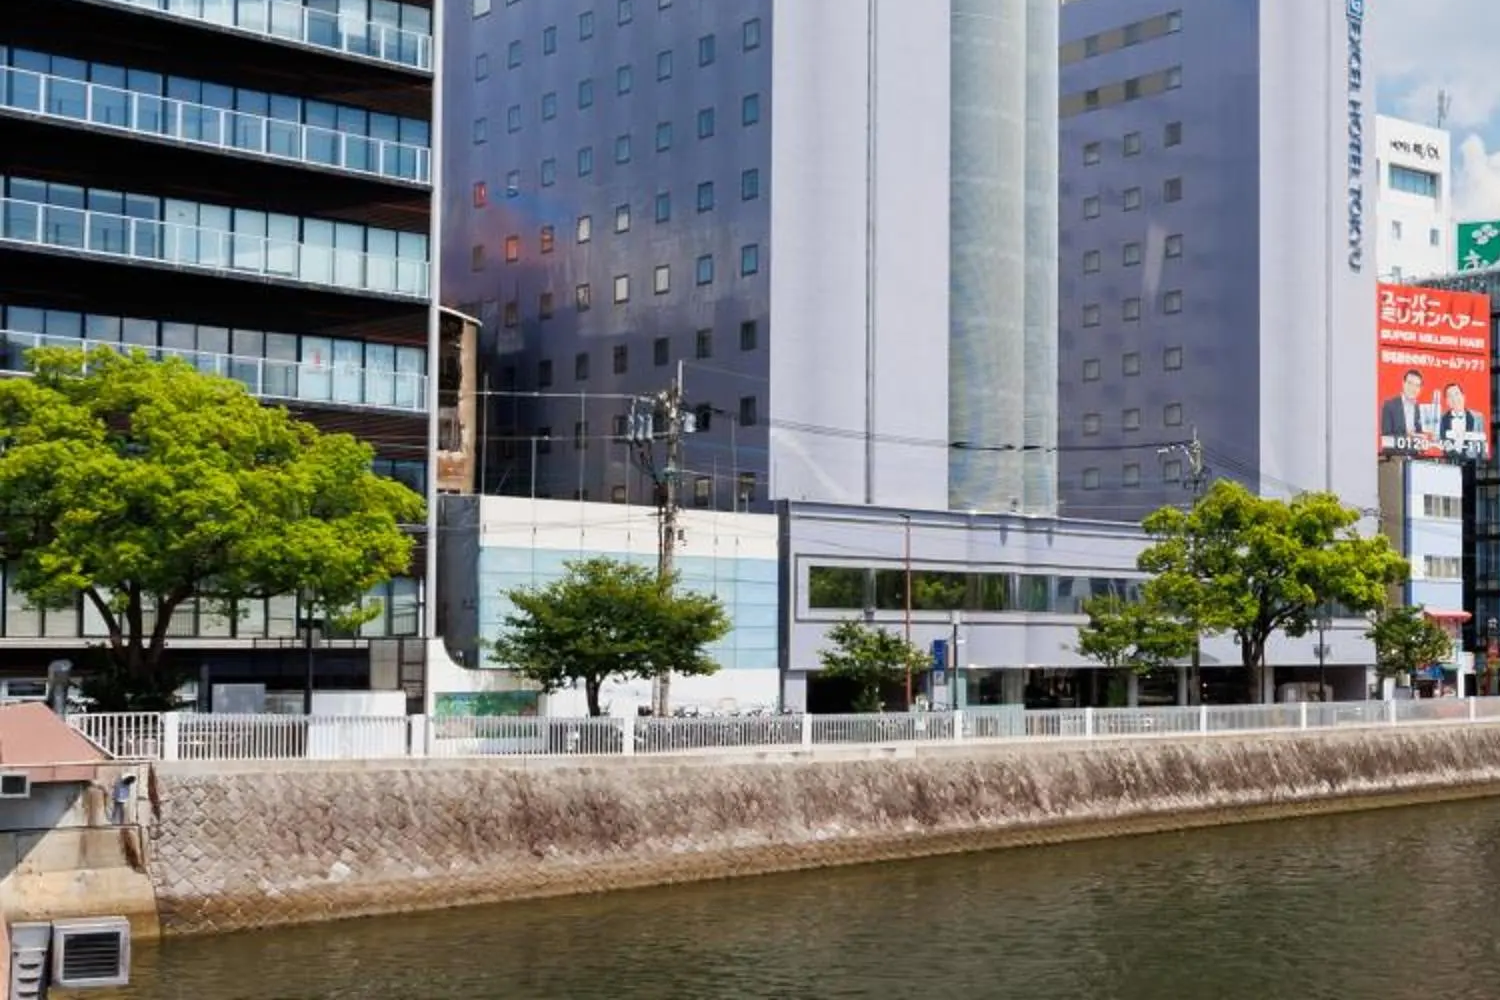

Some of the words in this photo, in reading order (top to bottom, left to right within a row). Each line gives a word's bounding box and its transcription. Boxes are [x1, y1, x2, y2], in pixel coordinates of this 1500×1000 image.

[1348, 20, 1363, 92] EXCEL
[1348, 99, 1363, 180] HOTEL
[1348, 184, 1363, 274] TOKYU
[1381, 291, 1440, 309] スーパー
[1381, 307, 1486, 331] ミリオンヘアー
